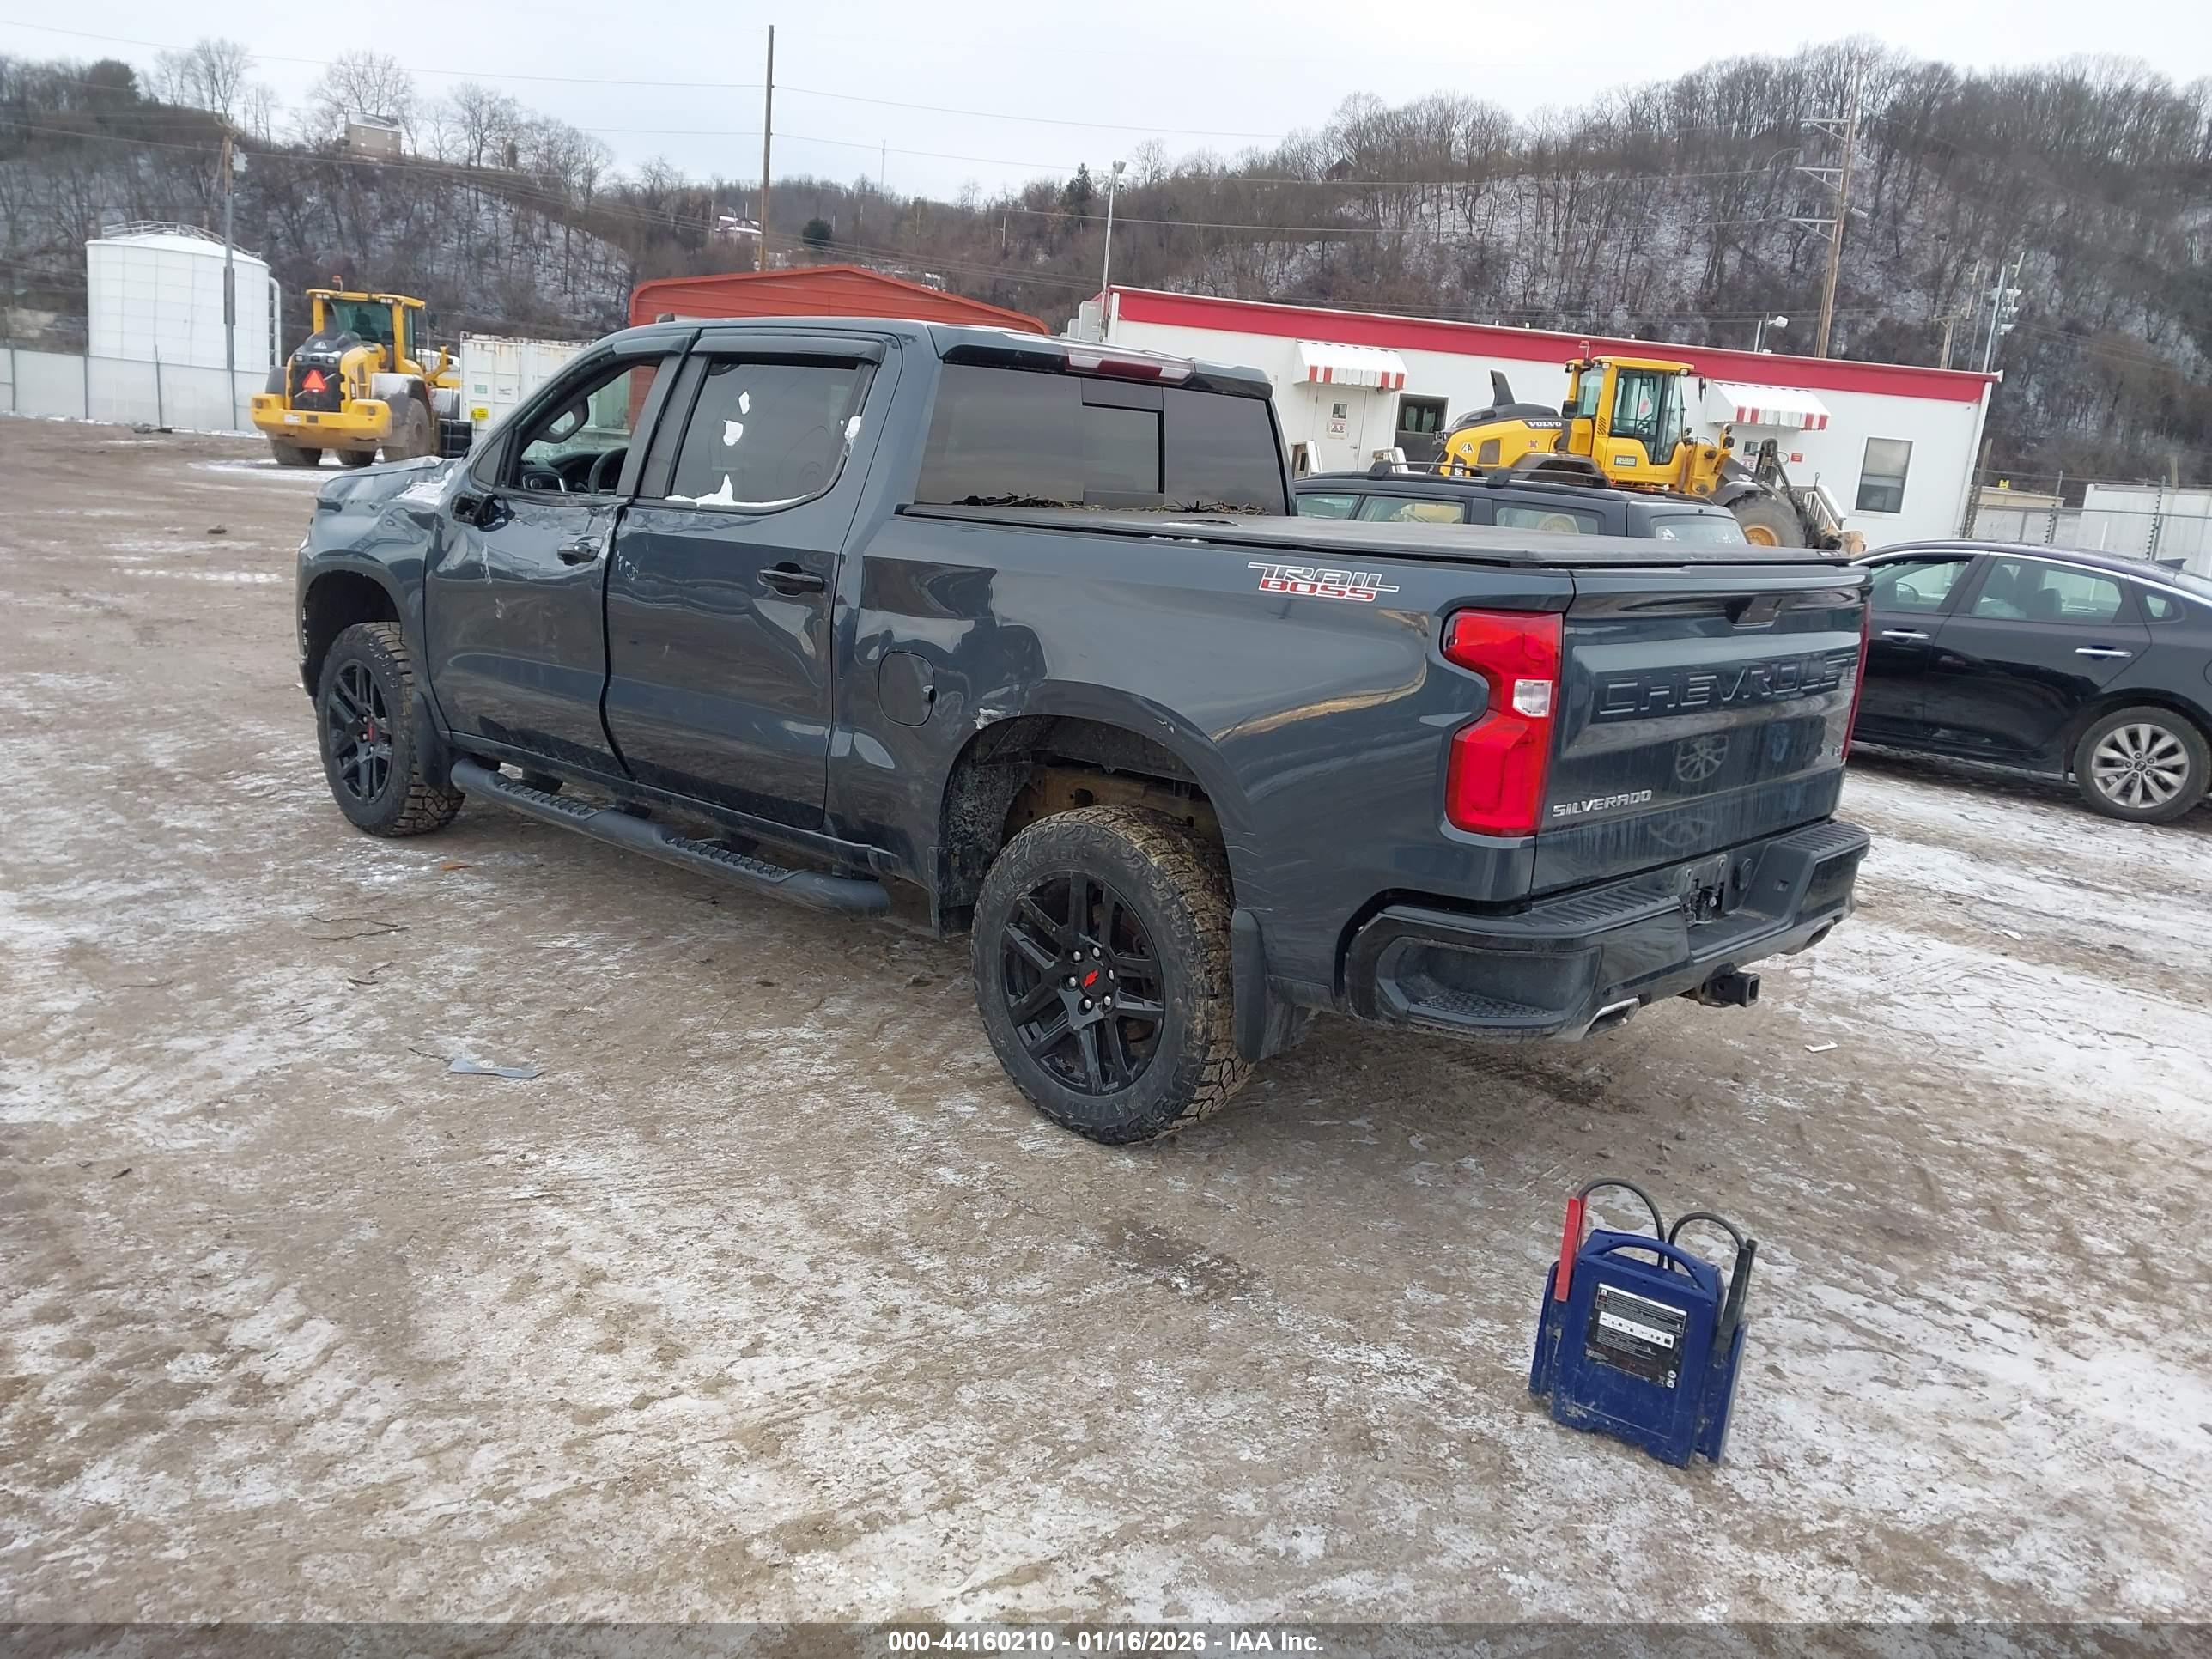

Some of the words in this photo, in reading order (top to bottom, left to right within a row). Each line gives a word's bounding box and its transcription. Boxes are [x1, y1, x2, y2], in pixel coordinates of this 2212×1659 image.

[1248, 562, 1400, 592] TRAIL
[1259, 579, 1376, 602] BOSS
[1599, 652, 1858, 714] CHEVROLET
[1552, 789, 1653, 817] SILVERADO
